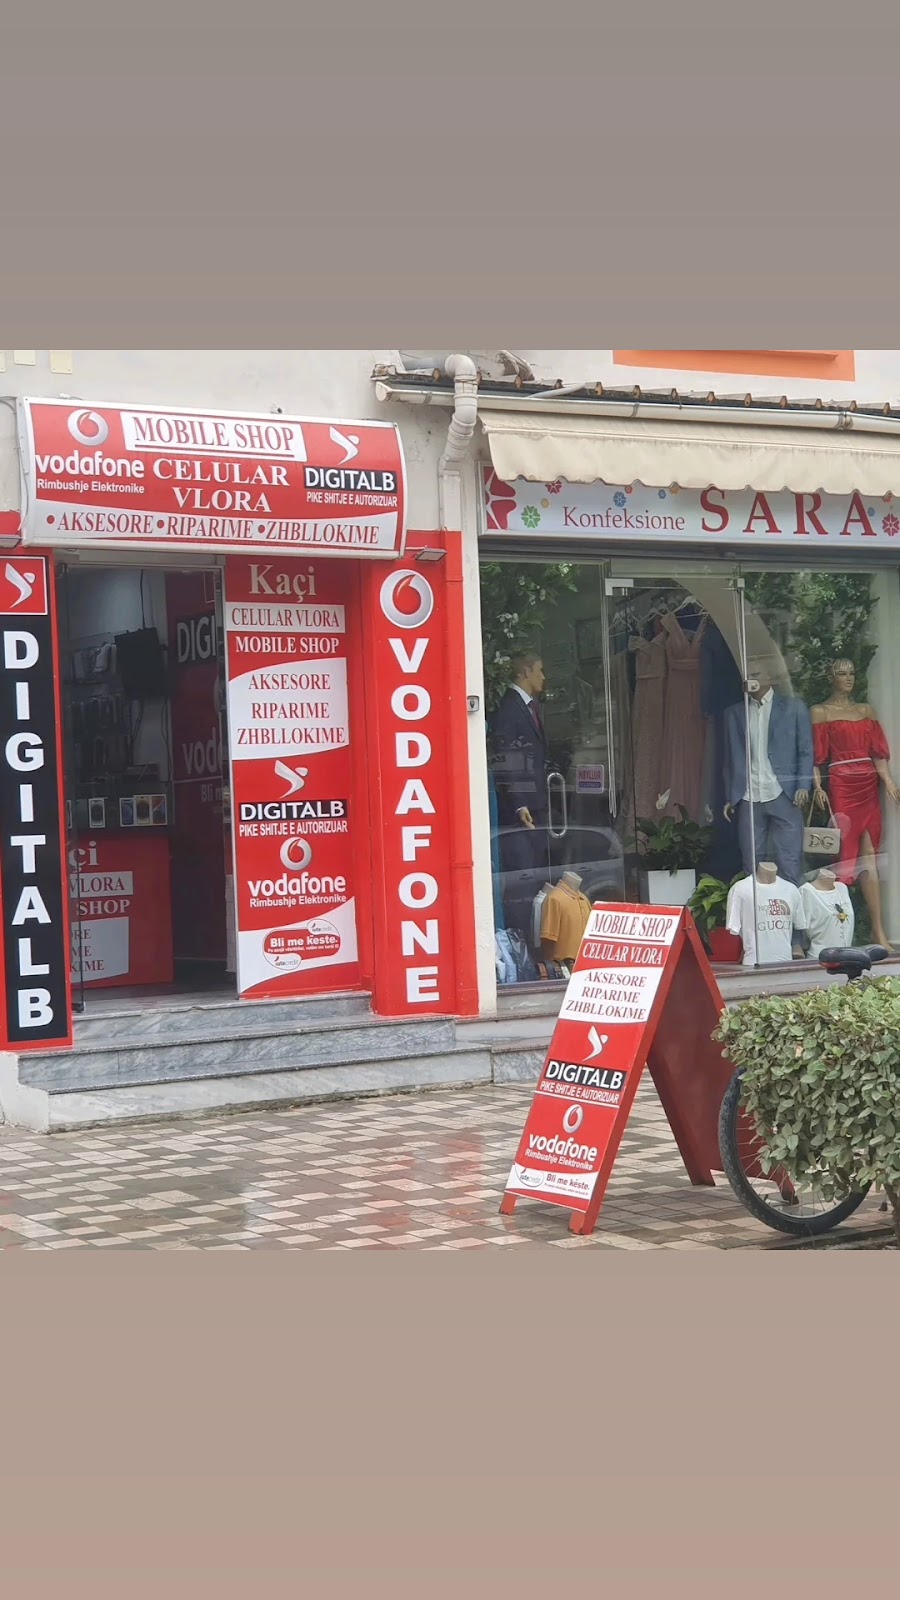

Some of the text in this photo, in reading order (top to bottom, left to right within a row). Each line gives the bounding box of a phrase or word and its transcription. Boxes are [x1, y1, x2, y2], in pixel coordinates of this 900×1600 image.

[132, 416, 294, 451] MOBILE SHOP
[35, 450, 144, 478] vodafone
[153, 458, 290, 487] CELULAR
[37, 478, 145, 494] Rimbushje Elektronike
[305, 467, 395, 491] DIGITALB
[172, 487, 272, 513] VLORA
[306, 491, 398, 507] PIKE SHITJE E AUTORIZUAR
[562, 506, 685, 531] Konfeksione
[700, 485, 877, 536] SARA
[57, 512, 380, 545] AKSESORE RIPARIME ZHBLLOKIME
[249, 564, 317, 603] Kaçi
[232, 607, 340, 628] CELULAR VLORA
[235, 636, 339, 654] MOBILE SHOP
[248, 673, 331, 690] AKSESORE
[252, 702, 330, 719] RIPARIME
[237, 727, 345, 745] ZHBLLOKIME
[240, 801, 345, 821] DIGITALB
[388, 638, 440, 1004] VODAFONE
[3, 631, 54, 1028] DIGITALB
[239, 820, 348, 837] PIKE SHITJE E AUTORIZUAR
[808, 833, 834, 850] DG
[248, 871, 346, 897] vodafone
[76, 899, 130, 916] SHOP
[250, 894, 346, 908] Rimbushje Elektronike
[591, 913, 672, 938] MOBILE SHOP
[758, 919, 791, 931] GUCCI
[270, 937, 284, 947] Bli
[287, 938, 304, 946] me
[582, 942, 663, 965] CELULAR VLORA
[584, 971, 647, 988] AKSESORE
[581, 987, 640, 1004] RIPARIME
[565, 999, 646, 1020] ZHBLLOKIME
[546, 1061, 623, 1090] DIGITALB
[540, 1081, 555, 1093] PIKE
[555, 1083, 576, 1097] SHITJE
[581, 1088, 620, 1104] AUTORIZUAR
[529, 1134, 597, 1162] vodafone
[525, 1149, 593, 1171] Rimbushje Elektronike
[546, 1173, 557, 1182] Bli
[557, 1177, 569, 1186] me
